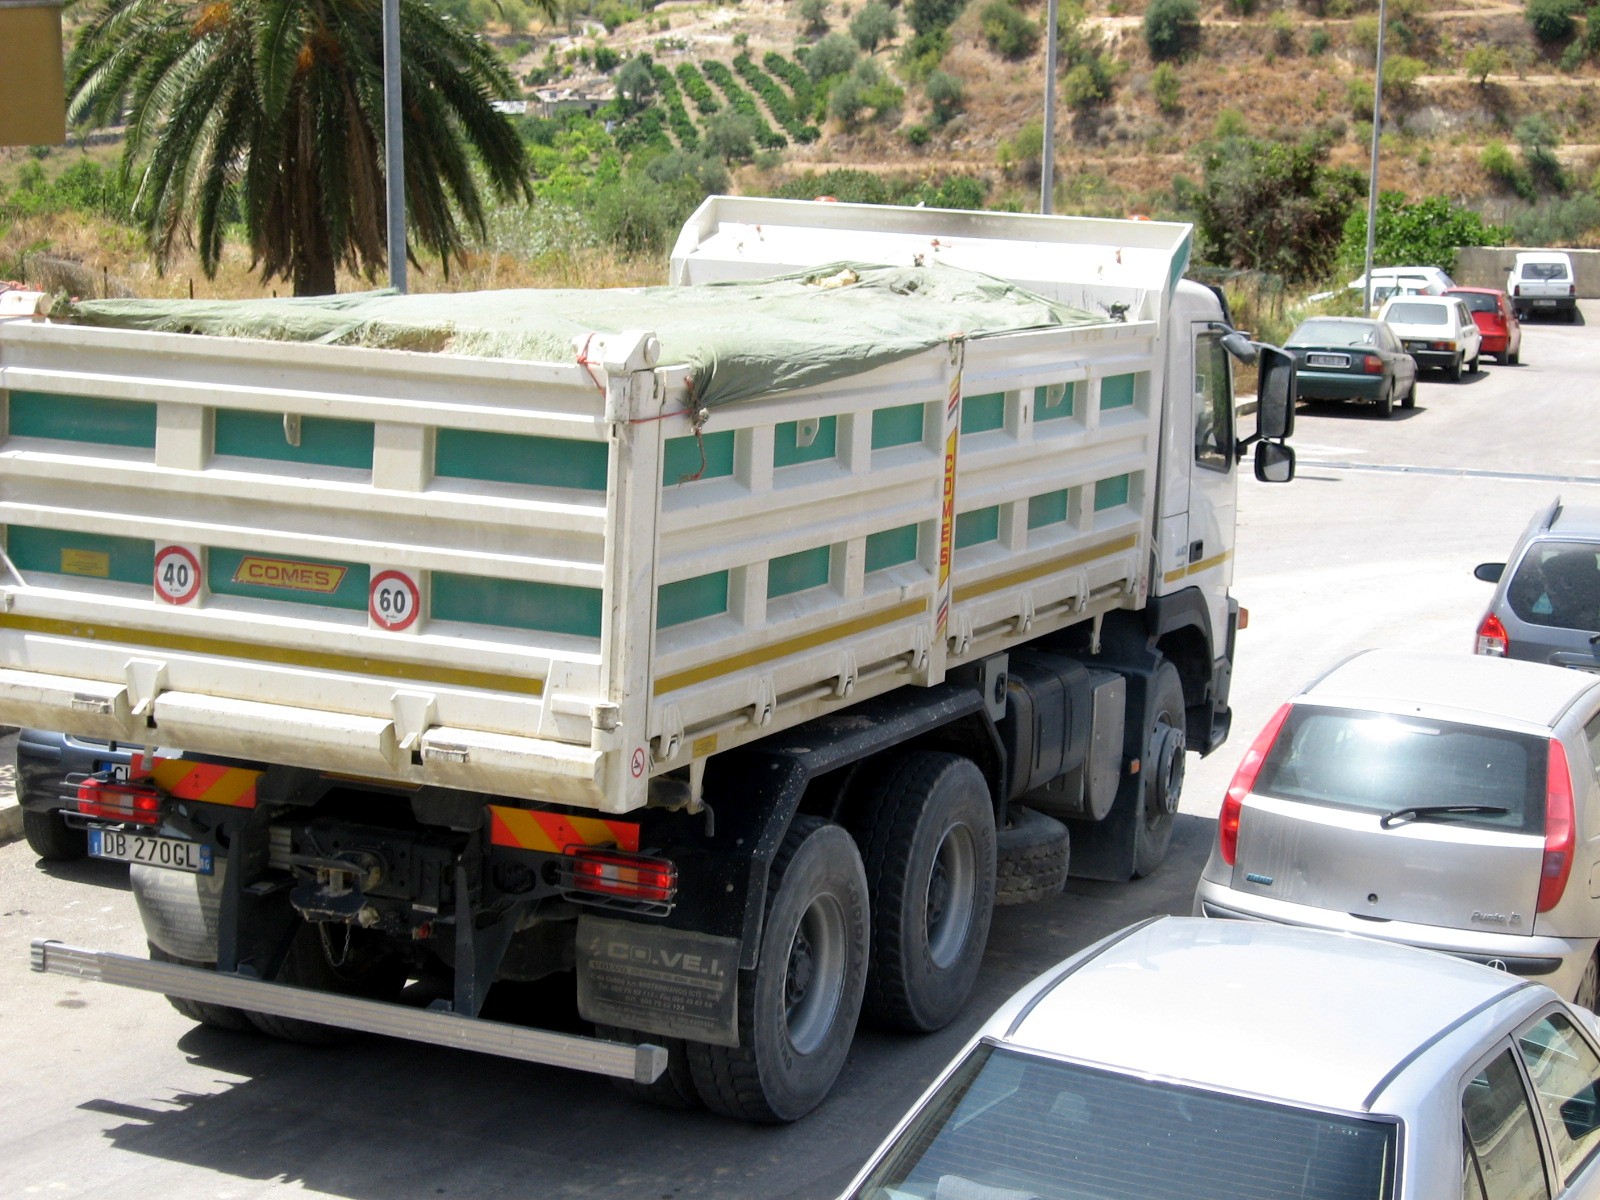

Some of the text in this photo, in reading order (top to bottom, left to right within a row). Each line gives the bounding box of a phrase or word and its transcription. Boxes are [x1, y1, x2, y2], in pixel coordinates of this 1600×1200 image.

[939, 454, 953, 566] COMES
[163, 562, 189, 588] 40
[249, 564, 330, 586] COMES
[379, 588, 406, 614] 60
[103, 832, 197, 869] DB 270GL
